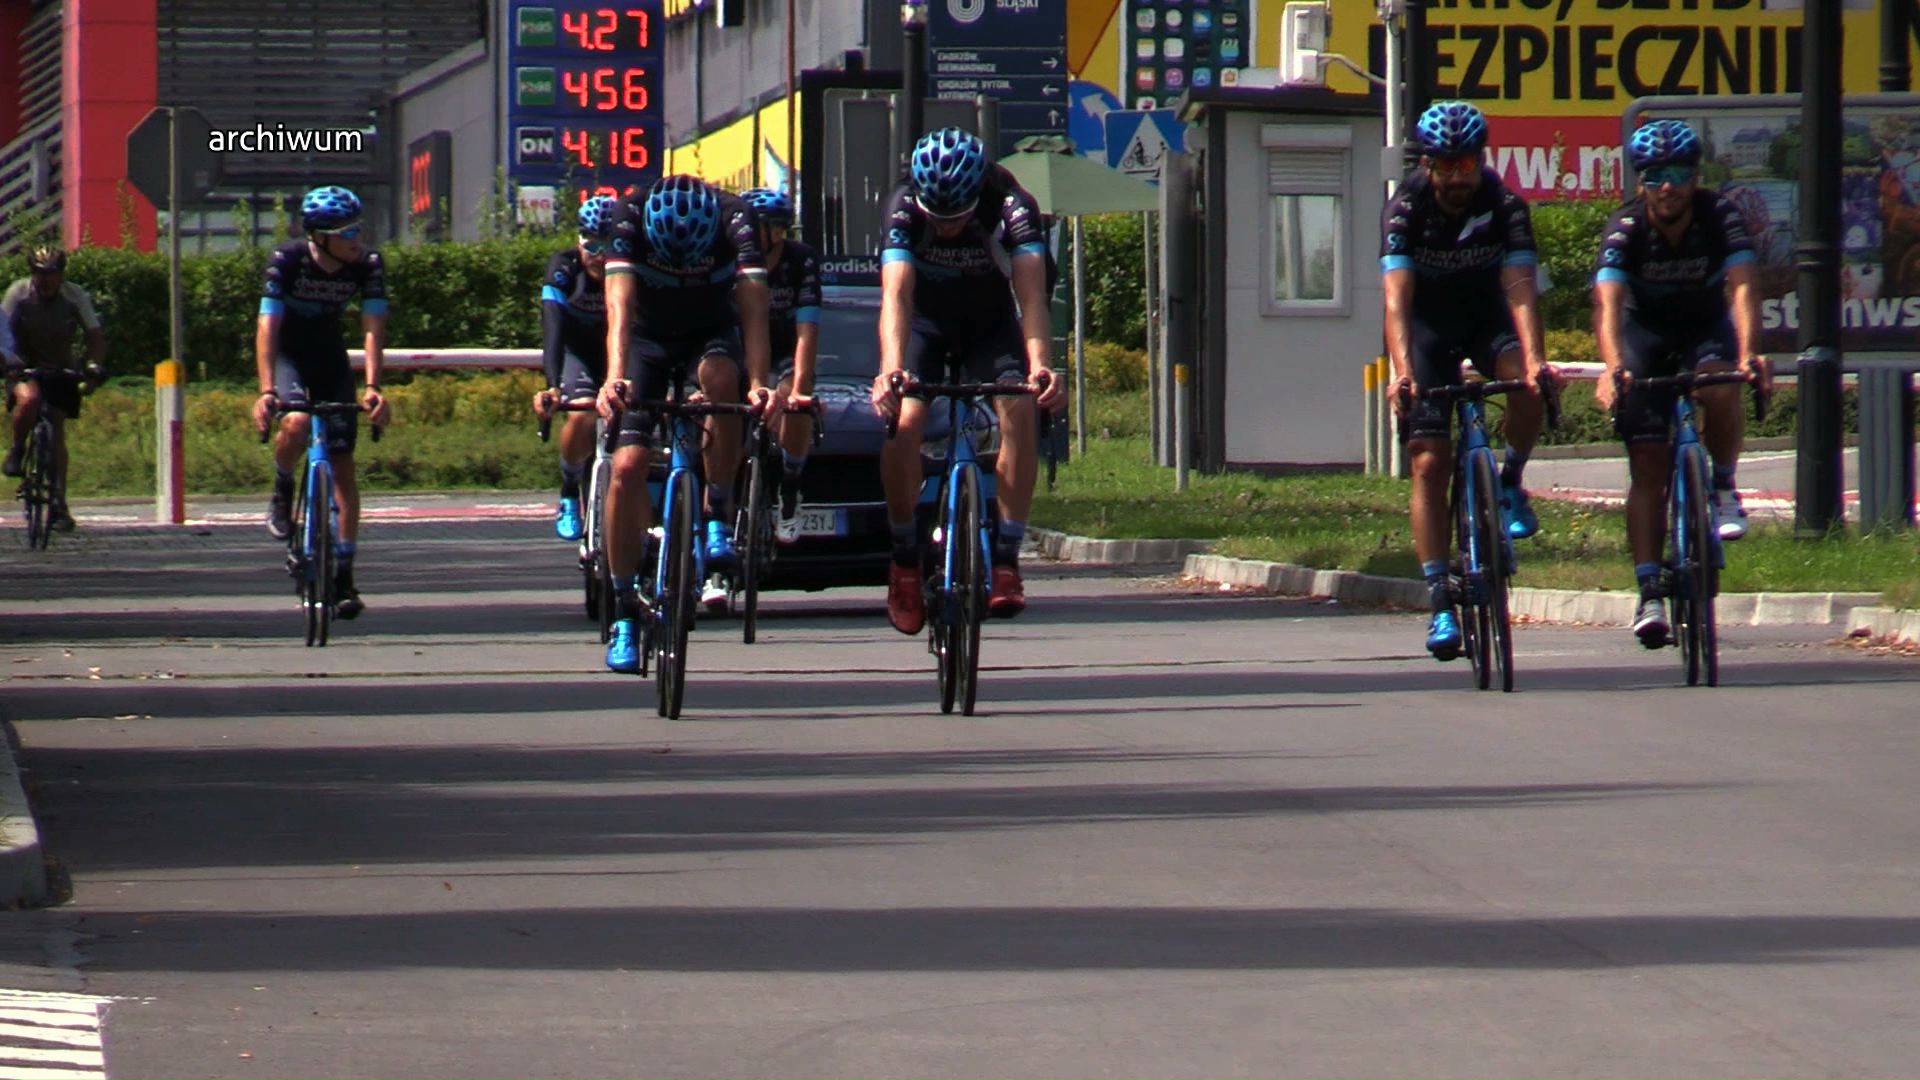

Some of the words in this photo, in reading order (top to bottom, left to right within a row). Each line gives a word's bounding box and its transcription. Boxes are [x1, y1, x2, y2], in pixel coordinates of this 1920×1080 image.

[562, 8, 648, 50] 4.27
[520, 138, 553, 153] ON
[562, 127, 648, 168] 4.16
